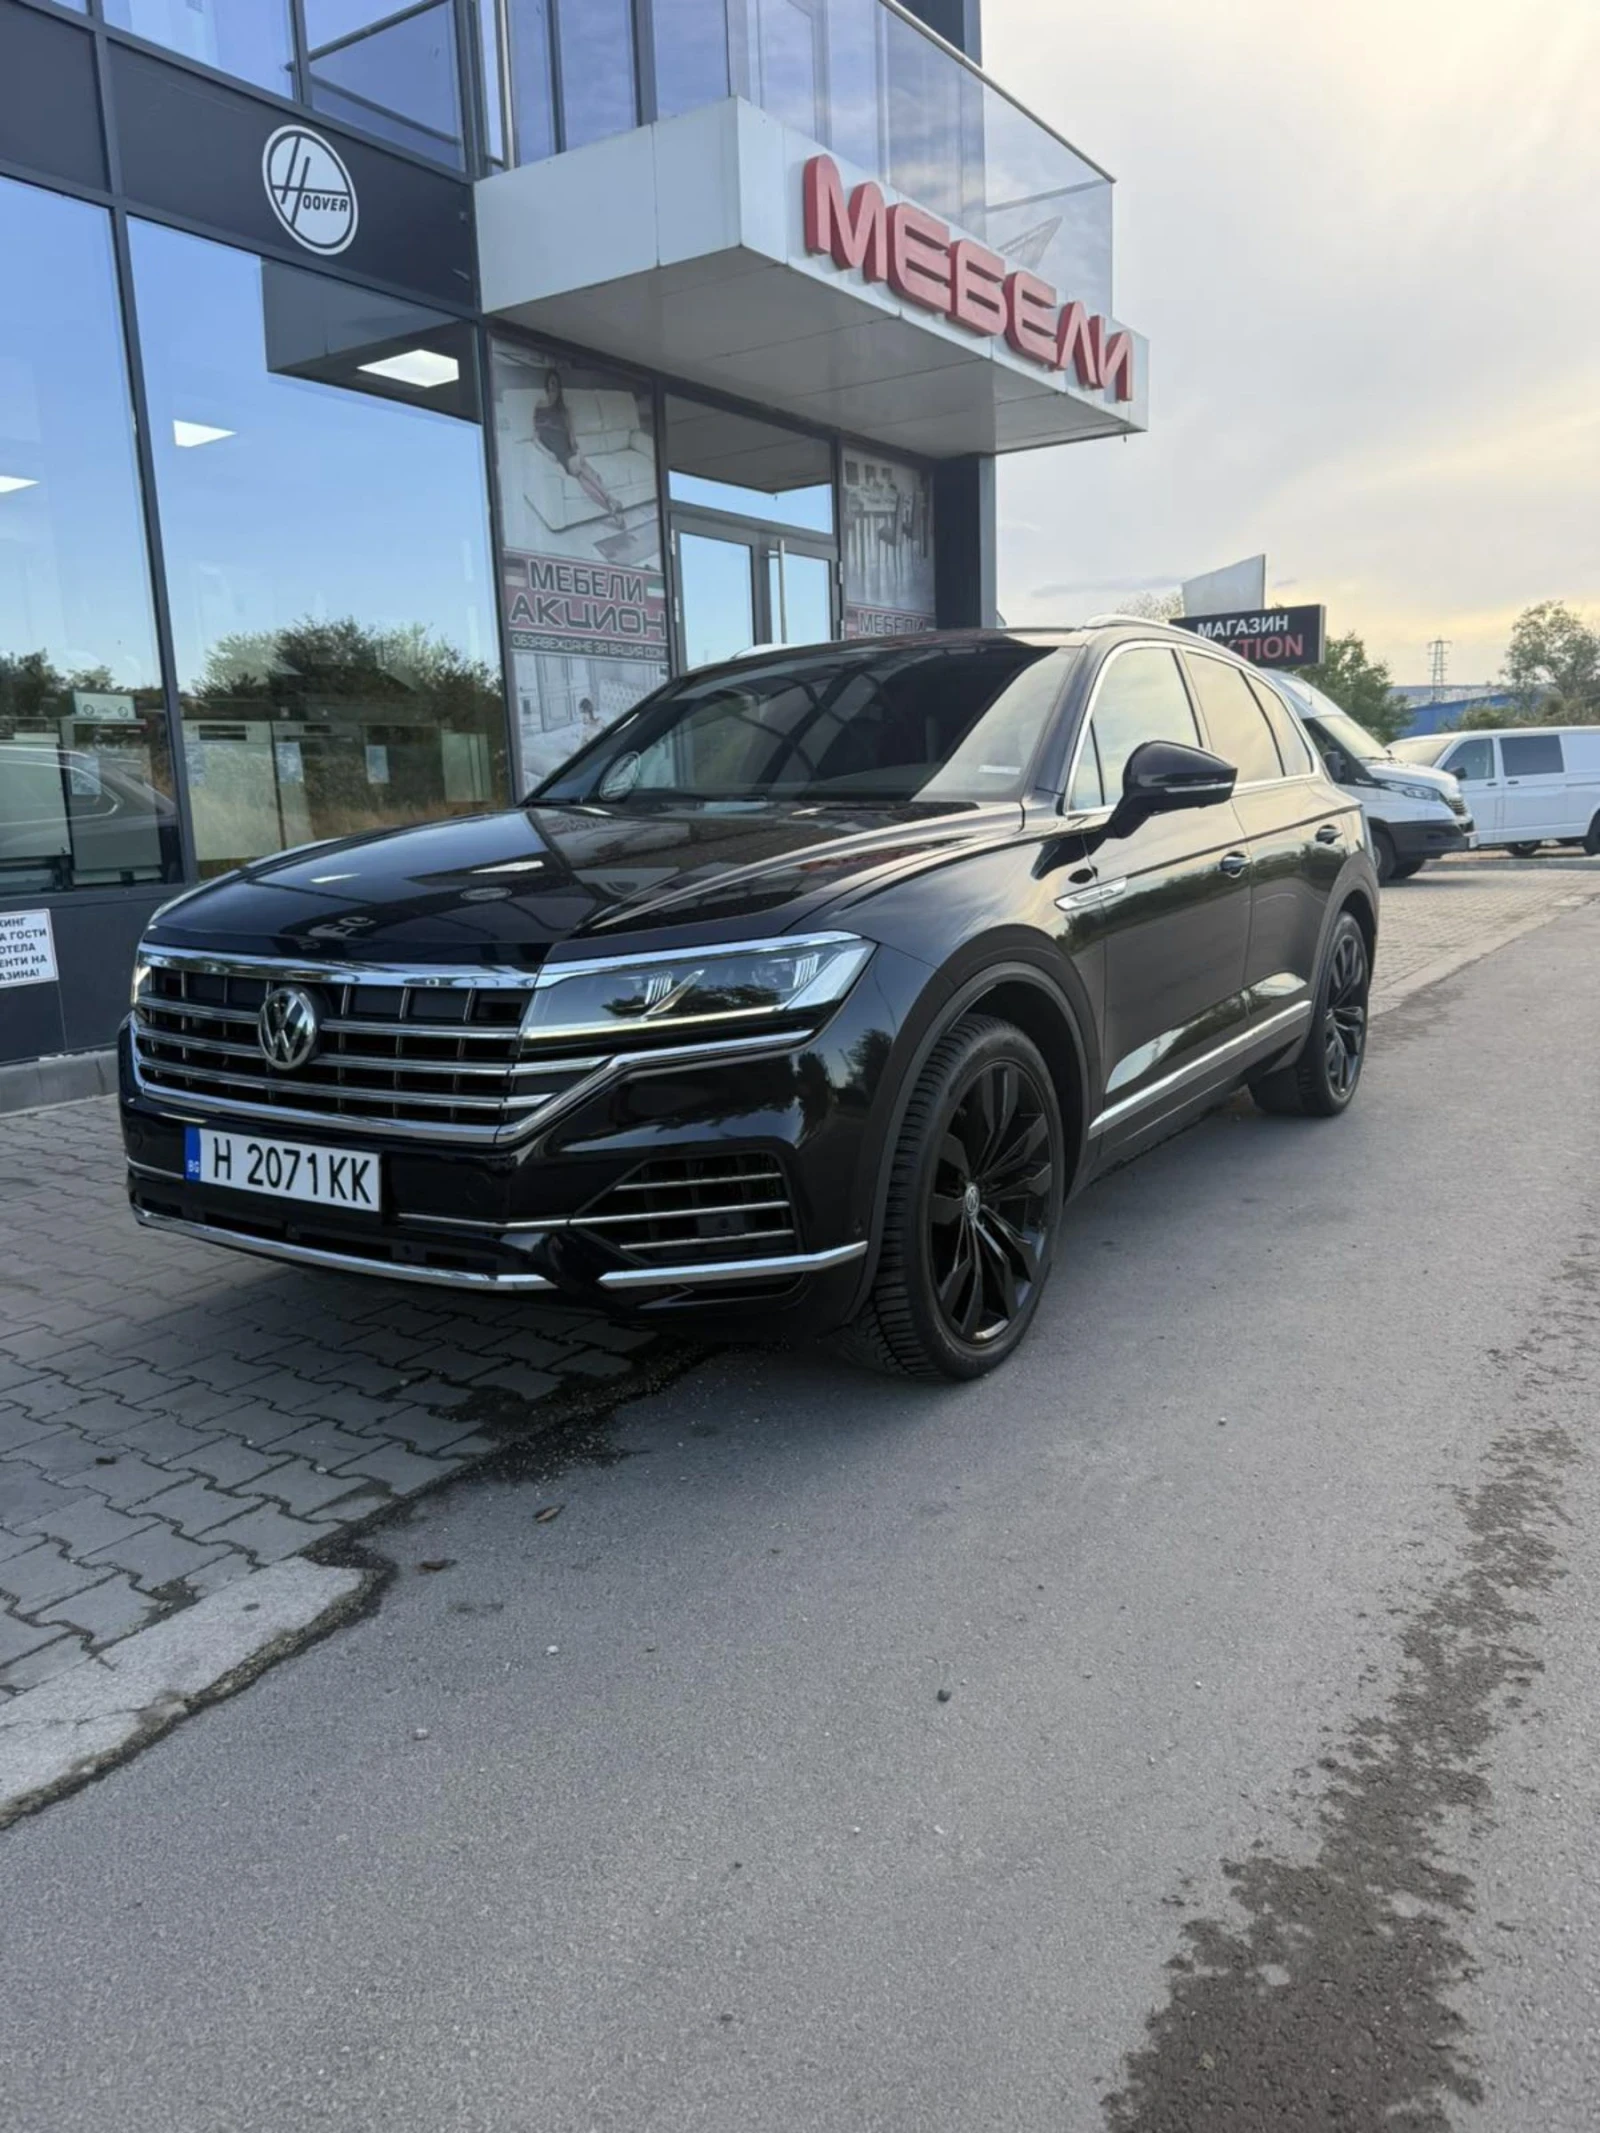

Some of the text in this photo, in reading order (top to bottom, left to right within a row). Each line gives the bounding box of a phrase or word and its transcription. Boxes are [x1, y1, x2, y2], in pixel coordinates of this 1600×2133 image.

[269, 134, 349, 229] HOOVER
[802, 153, 1133, 402] МЕБЕЛИ
[528, 559, 644, 604] МЕБЕЛИ
[509, 593, 668, 639] АКЦИОН
[857, 609, 926, 635] МЕБЕЛИ
[1197, 614, 1289, 638] МАГАЗИН
[10, 928, 47, 941] ГОСТИ
[31, 954, 47, 964] НА
[213, 1136, 232, 1181] H
